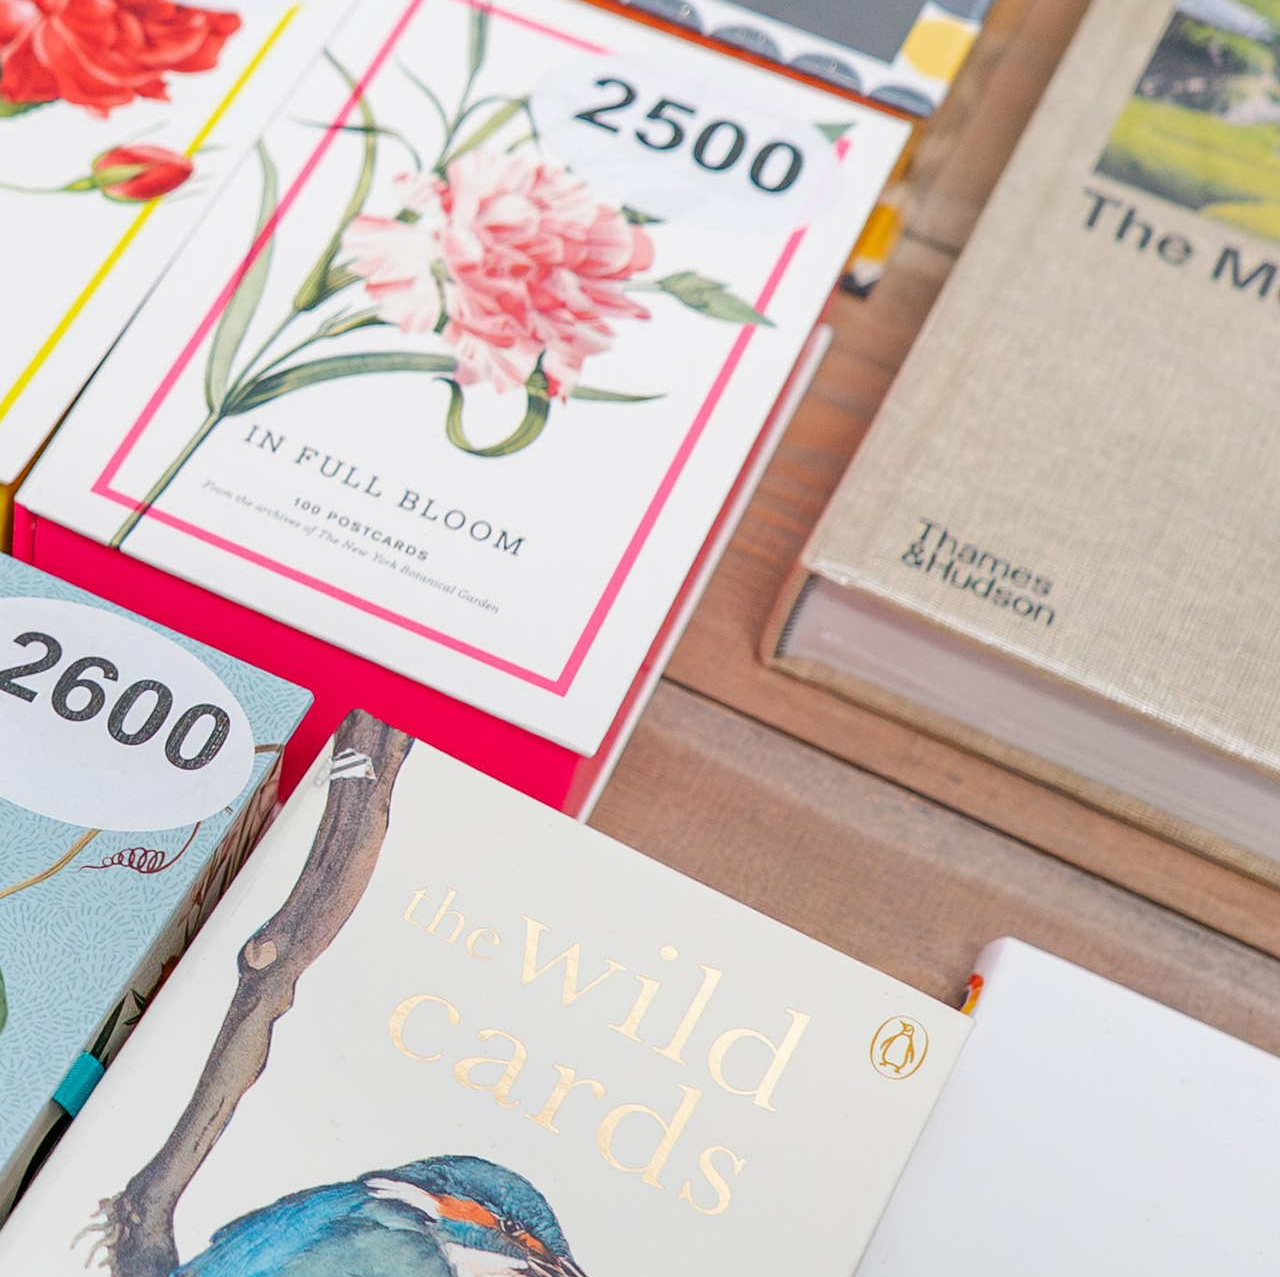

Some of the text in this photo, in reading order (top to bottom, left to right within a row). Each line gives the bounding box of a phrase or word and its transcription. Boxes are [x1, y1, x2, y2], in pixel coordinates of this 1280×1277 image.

[573, 78, 803, 193] 2500
[1083, 187, 1280, 306] The M
[202, 479, 500, 614] From the archives of The New York Botanical Garden
[243, 424, 526, 557] IN FULL BLOOM
[293, 497, 429, 562] 100 POSTCARDS
[901, 541, 1055, 626] &Hudson
[920, 516, 1052, 596] Thames
[403, 886, 812, 1113] the wild
[388, 993, 747, 1216] cards
